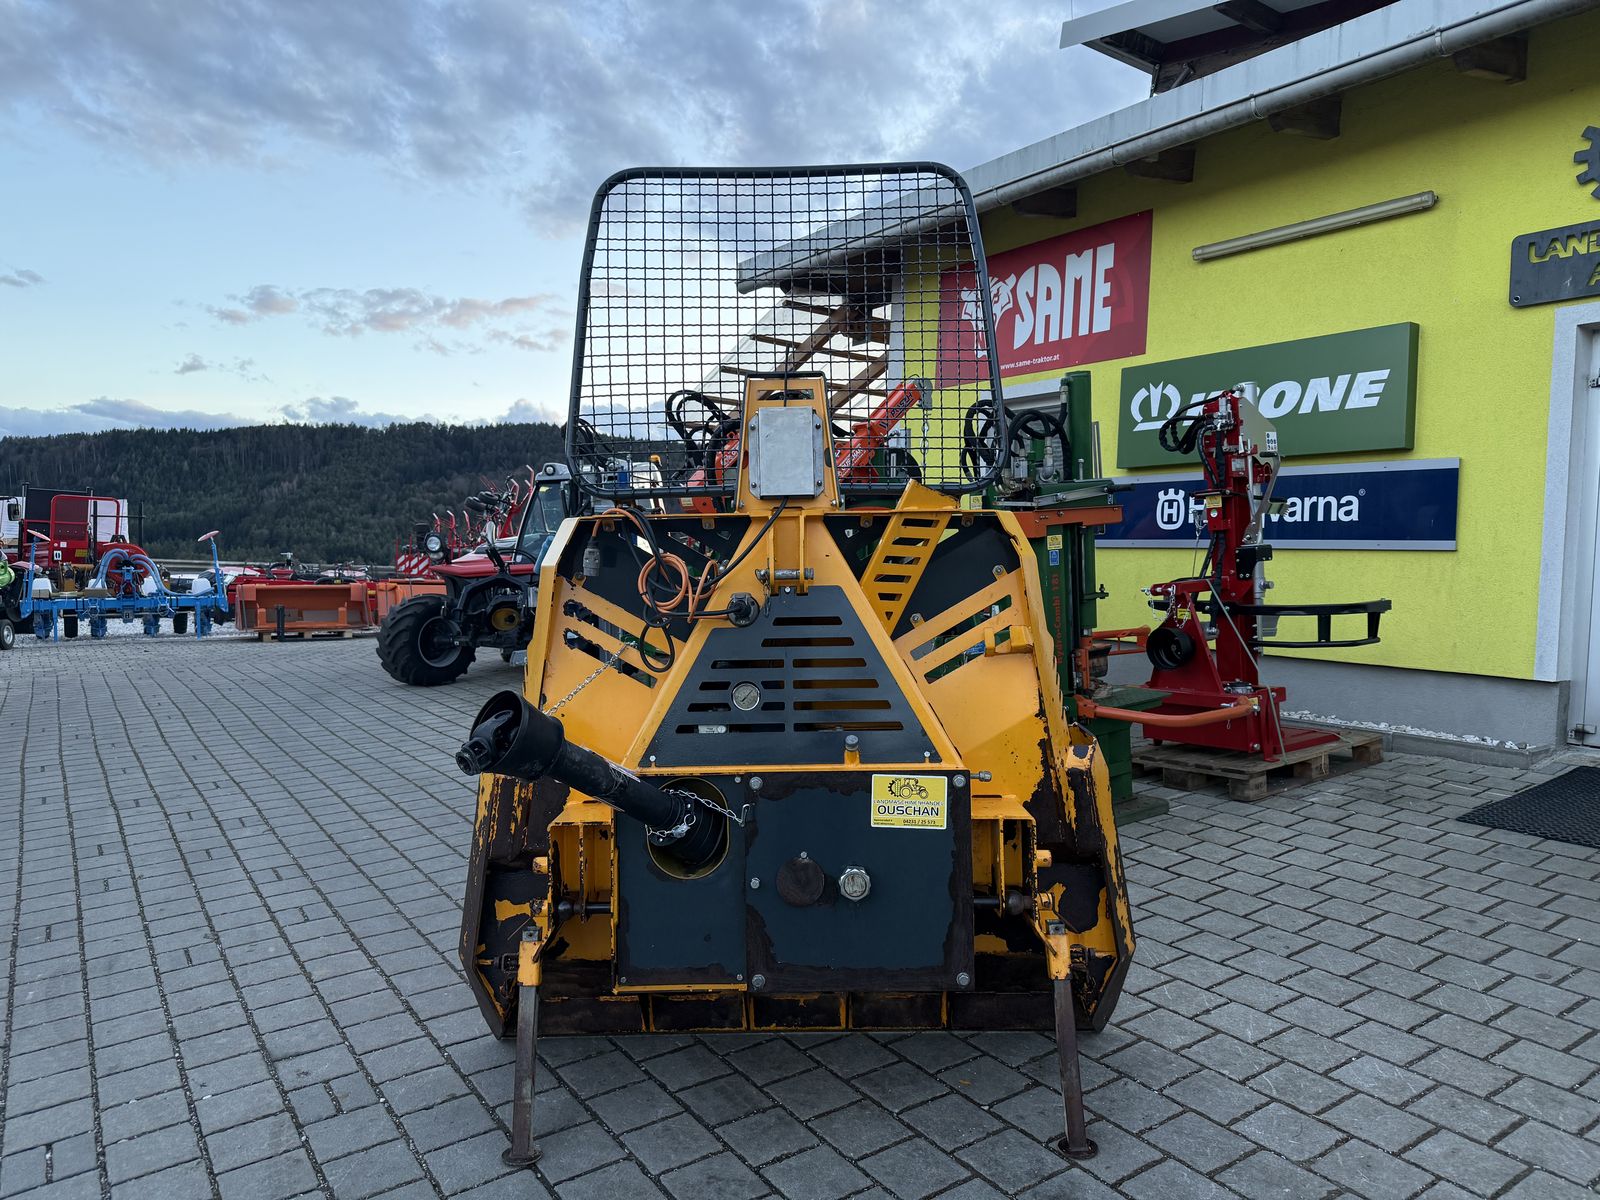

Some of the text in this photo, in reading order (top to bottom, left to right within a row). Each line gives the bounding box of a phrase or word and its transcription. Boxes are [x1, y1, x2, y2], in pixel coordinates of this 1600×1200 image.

[1013, 243, 1115, 350] SAME
[1000, 354, 1060, 370] www.same-traktor.at
[1186, 368, 1391, 426] KONE
[1188, 494, 1359, 528] Harna
[877, 805, 939, 816] OUSCHAN
